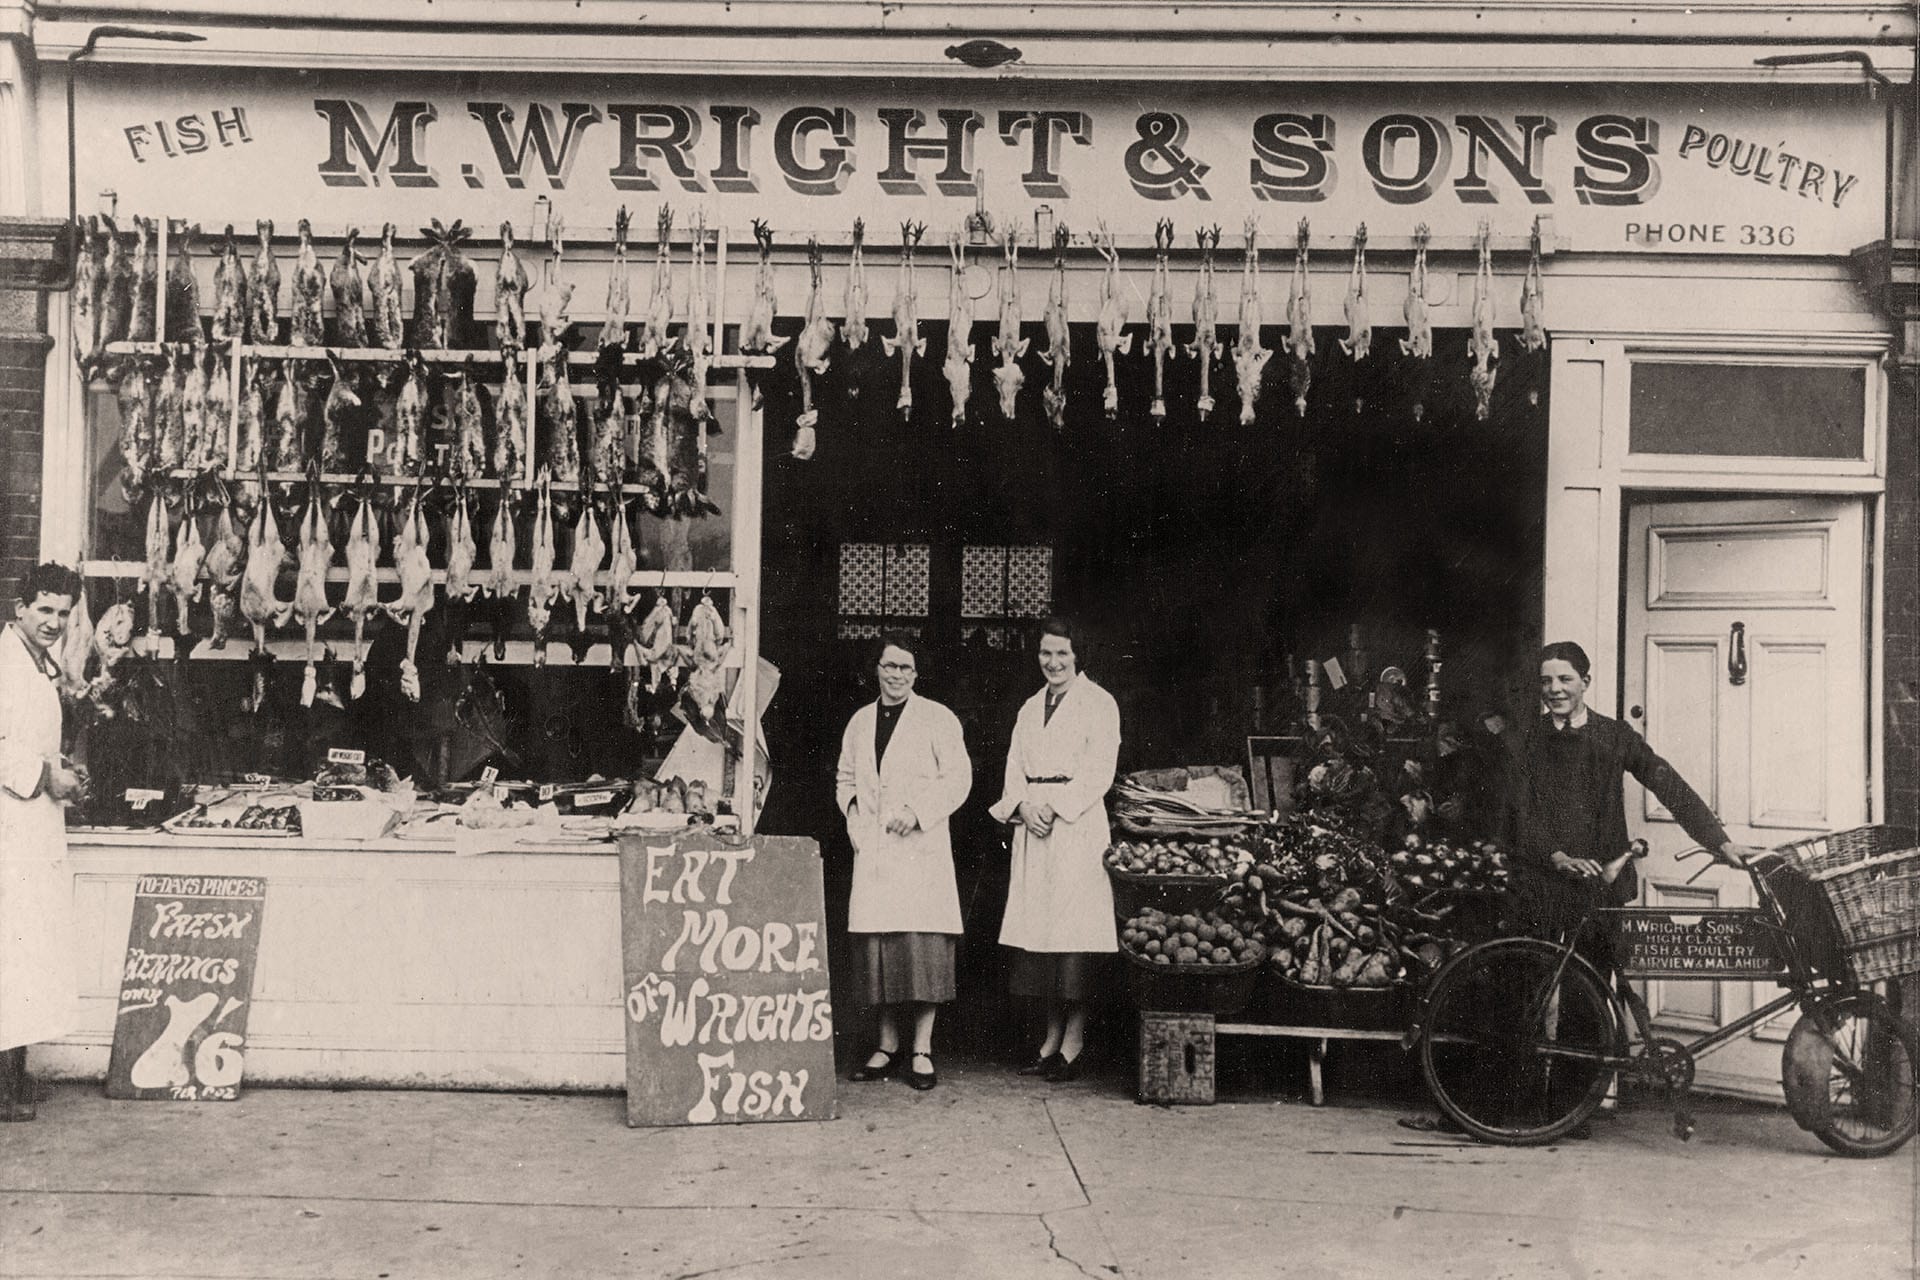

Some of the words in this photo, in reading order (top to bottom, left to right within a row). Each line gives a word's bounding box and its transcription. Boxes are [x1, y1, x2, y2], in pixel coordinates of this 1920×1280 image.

[123, 107, 253, 162] FISH
[1123, 113, 1211, 201] &
[1249, 115, 1662, 206] SONS
[1678, 123, 1859, 210] POULTRY
[1625, 222, 1726, 243] PHONE
[1739, 225, 1796, 246] 336
[642, 842, 756, 912] EAT
[149, 900, 253, 939] FRESH
[661, 908, 821, 974] MORE
[1646, 934, 1681, 945] HIGH
[1685, 934, 1733, 945] CLASS
[1706, 920, 1744, 935] SONS
[123, 947, 240, 985] HERRINGS
[1630, 957, 1694, 969] FAIRVIEW
[1634, 944, 1669, 956] FISH
[1672, 947, 1682, 957] &
[1687, 945, 1755, 957] POULTRY
[659, 977, 833, 1048] WRIGHTS
[687, 1049, 810, 1123] FISH
